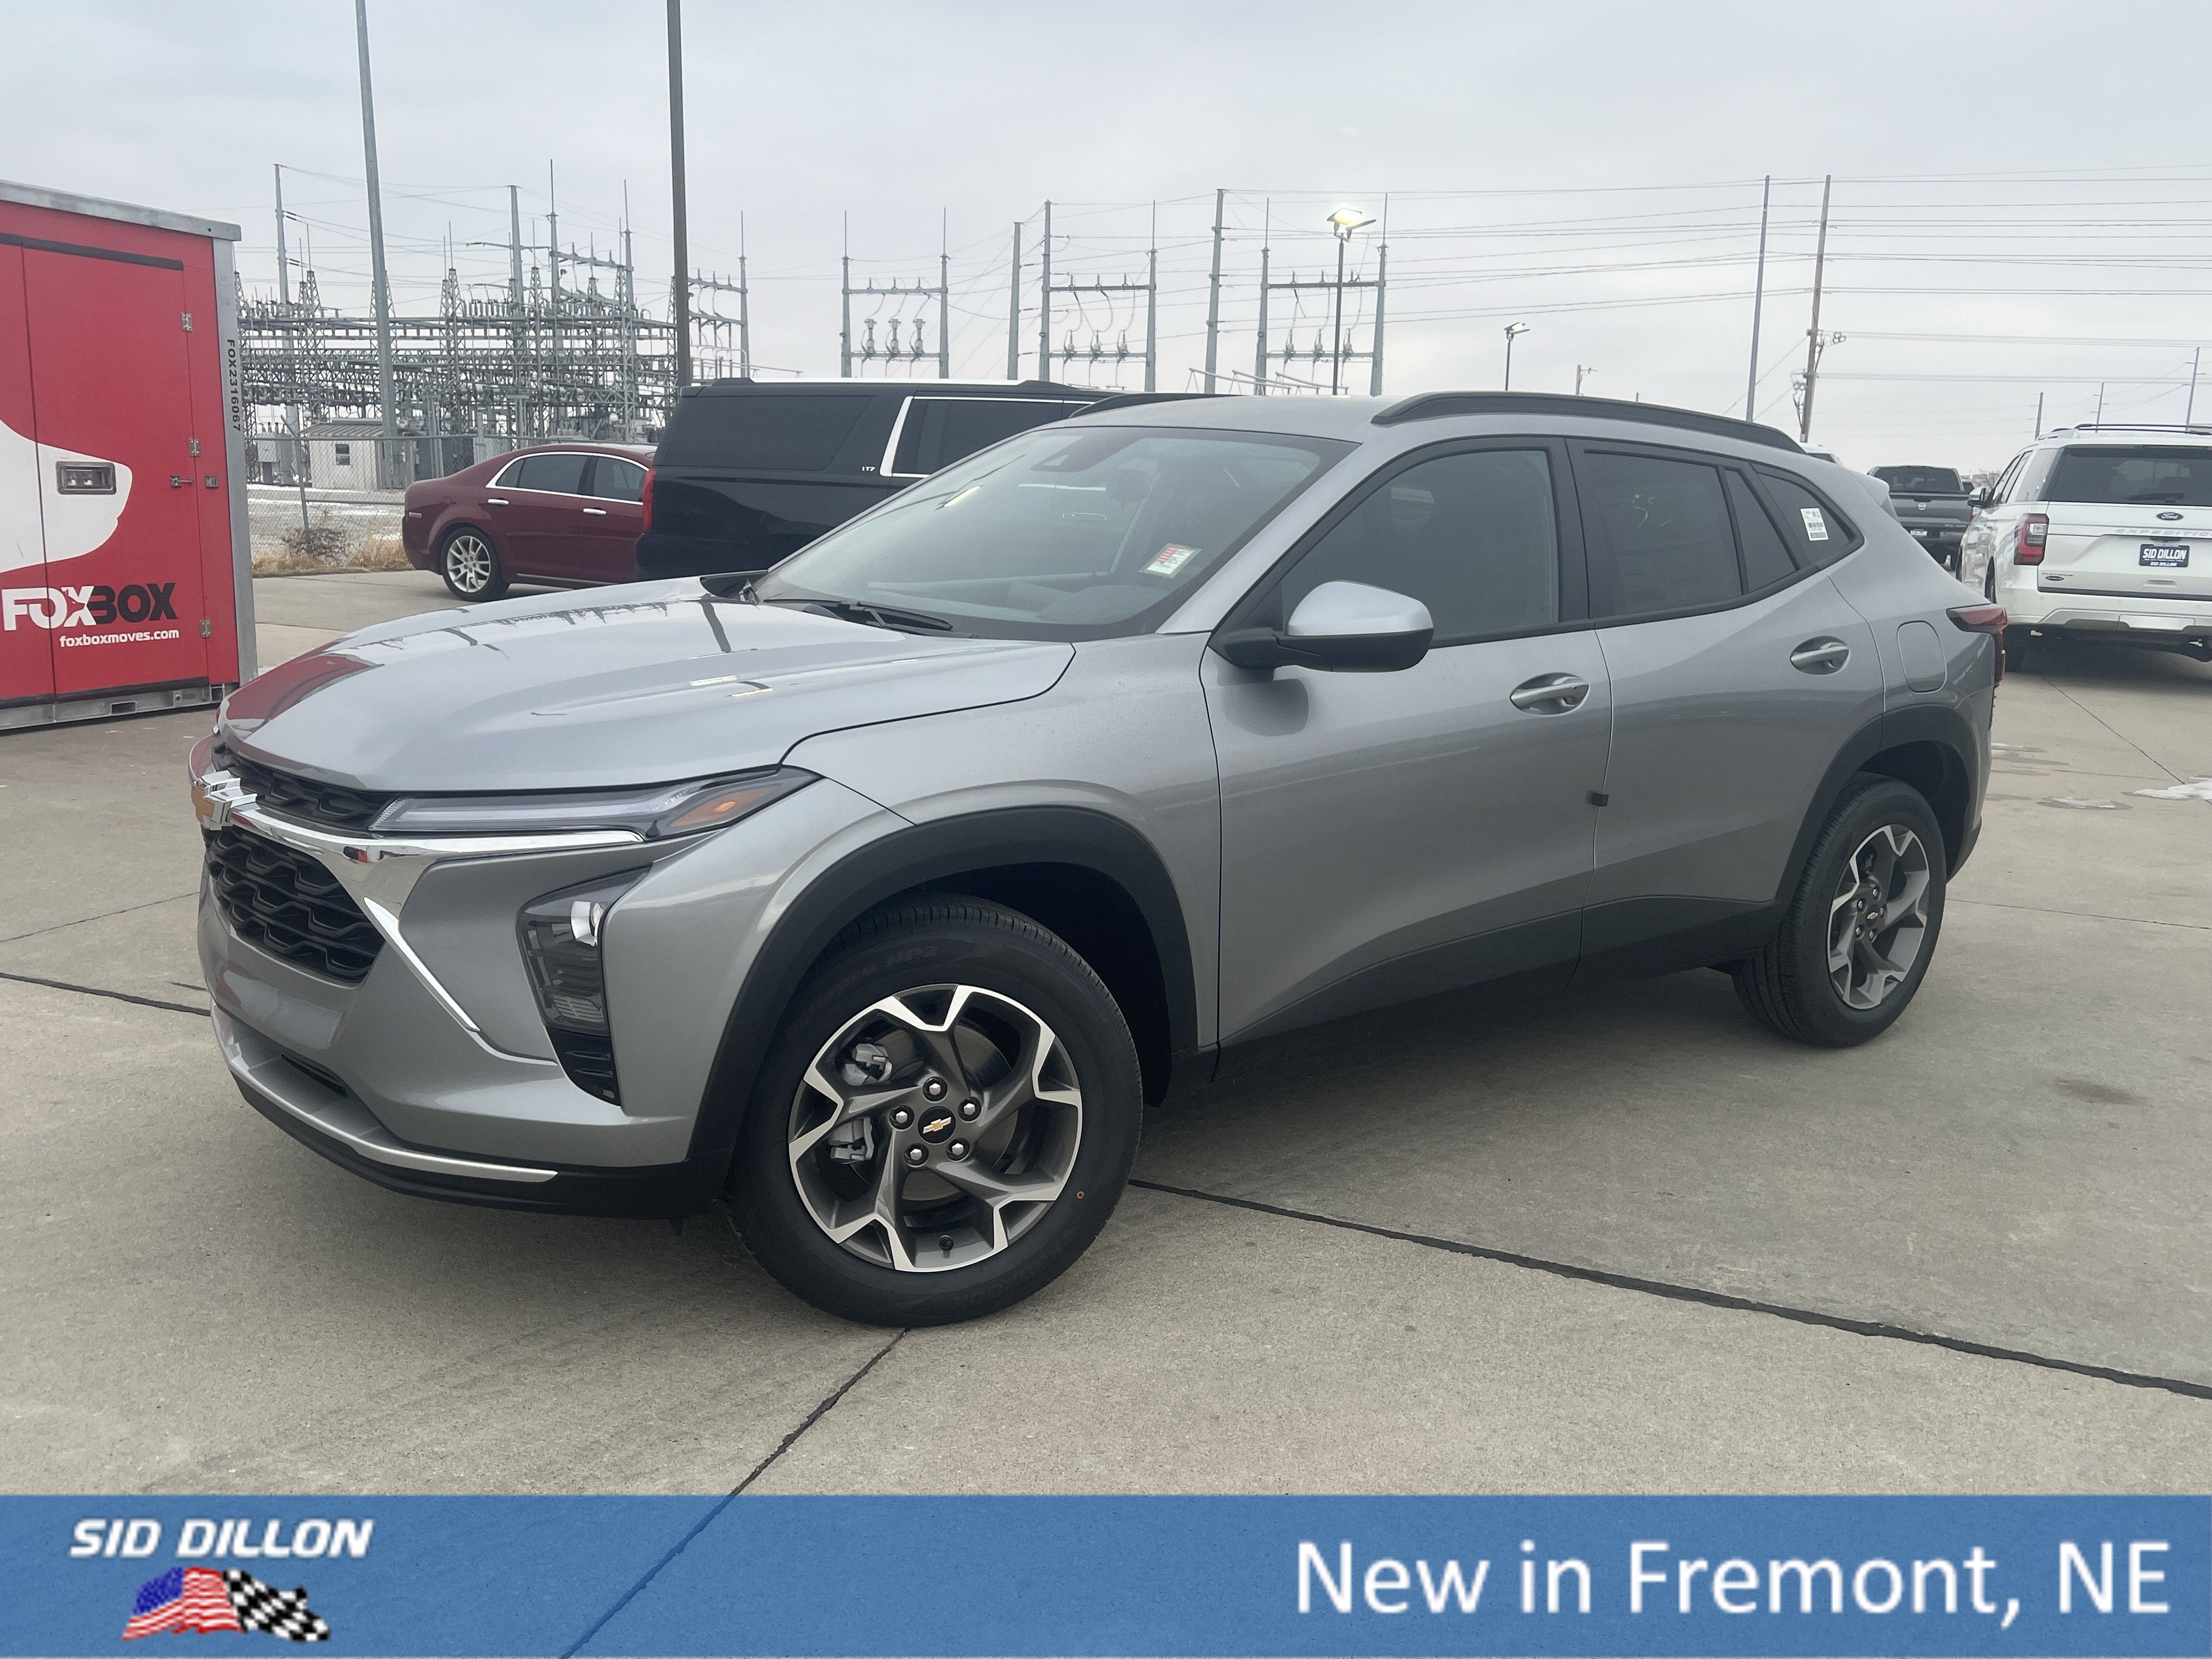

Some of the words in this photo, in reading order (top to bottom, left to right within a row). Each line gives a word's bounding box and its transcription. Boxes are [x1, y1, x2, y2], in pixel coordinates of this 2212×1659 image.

[227, 339, 241, 432] FOX2316067
[2142, 548, 2157, 558] SID
[2157, 549, 2187, 560] DILLON
[59, 629, 180, 647] foxboxmoves.com
